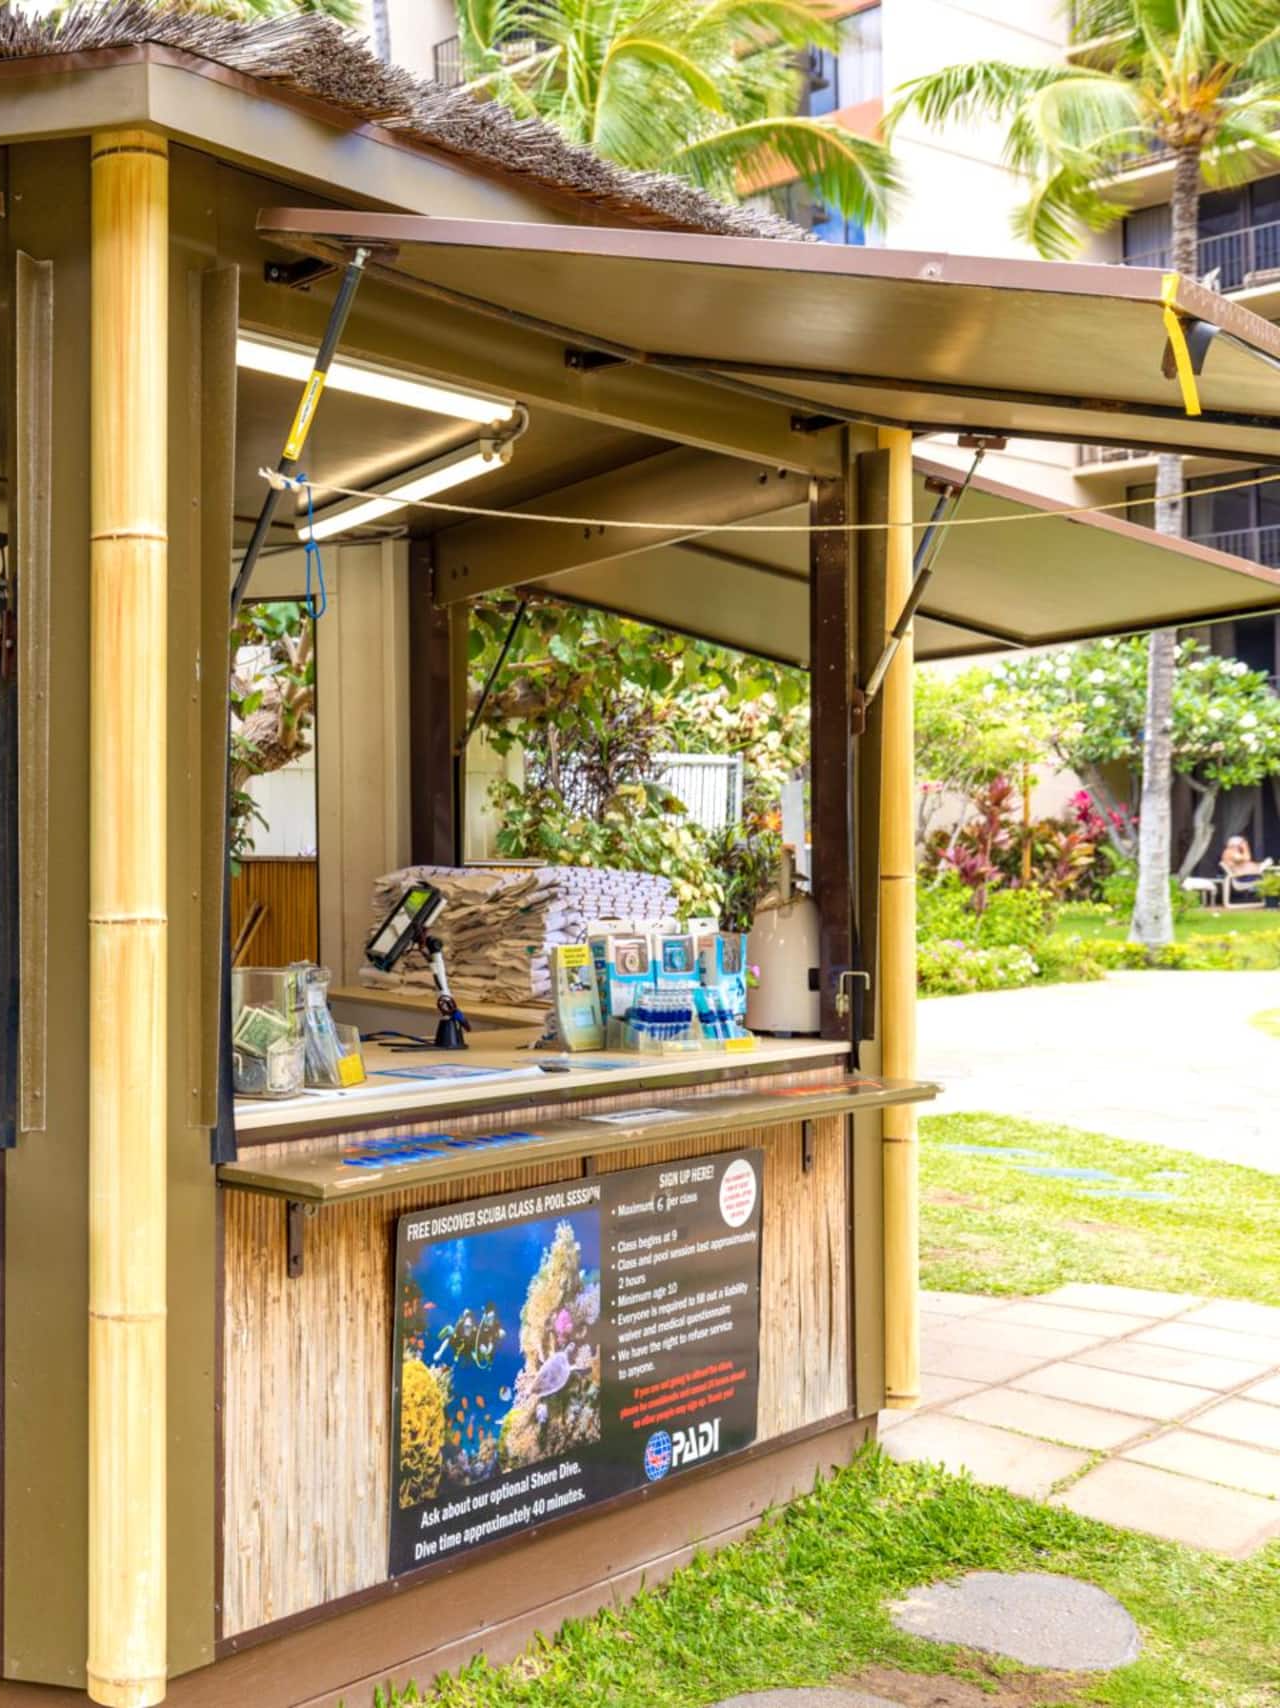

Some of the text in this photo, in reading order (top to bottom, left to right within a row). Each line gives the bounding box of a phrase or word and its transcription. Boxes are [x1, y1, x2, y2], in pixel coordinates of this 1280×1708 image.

[659, 1171, 678, 1188] SIGN
[680, 1168, 690, 1185] UP
[656, 1197, 664, 1211] 6
[407, 1221, 431, 1242] FREE
[432, 1212, 476, 1237] DISCOVER
[477, 1204, 506, 1226] SCUBA
[508, 1200, 535, 1220] CLASS
[536, 1198, 543, 1214] &
[544, 1194, 566, 1212] POOL
[617, 1241, 637, 1253] Class
[638, 1235, 661, 1249] begins
[617, 1259, 637, 1271] Class
[618, 1274, 646, 1289] 2 hours
[671, 1418, 720, 1467] PADI
[421, 1461, 582, 1529] Ask about our optional Shore Dive.
[414, 1487, 586, 1561] Dive time approximately 40 minutes.
